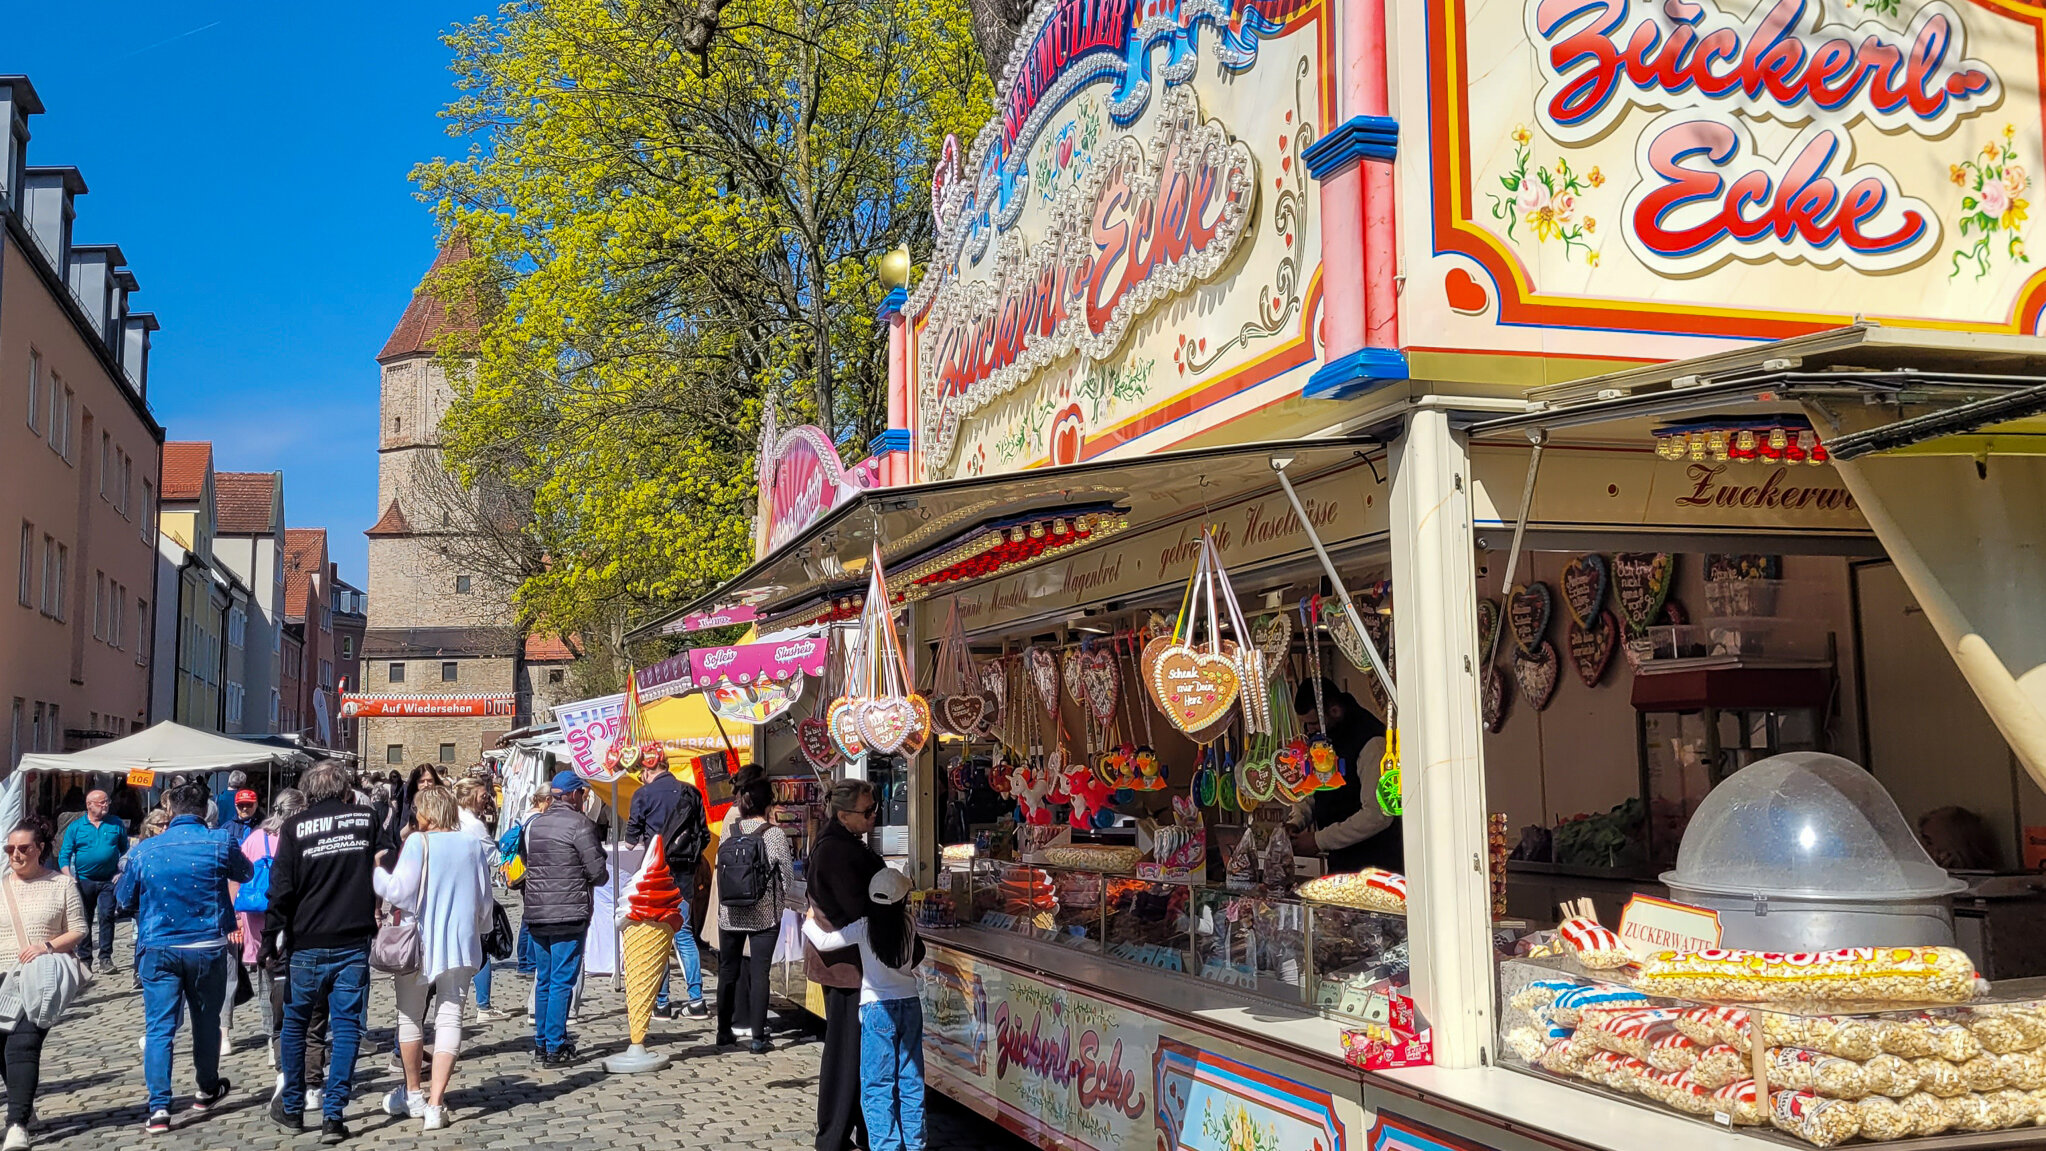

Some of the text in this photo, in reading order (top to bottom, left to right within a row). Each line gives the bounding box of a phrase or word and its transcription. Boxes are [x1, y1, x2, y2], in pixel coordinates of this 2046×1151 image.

[1633, 119, 1928, 258] Ecke
[1168, 666, 1199, 679] Schenk
[1177, 683, 1193, 693] mir
[381, 703, 401, 713] Auf
[403, 702, 472, 714] Wiedersehen
[484, 700, 515, 716] DULT
[1184, 695, 1203, 707] Herz
[131, 775, 149, 784] 106
[771, 781, 823, 803] SOFTE
[296, 816, 333, 839] CREW
[318, 833, 354, 846] RACING
[1624, 921, 1712, 951] ZUCKERWATTE
